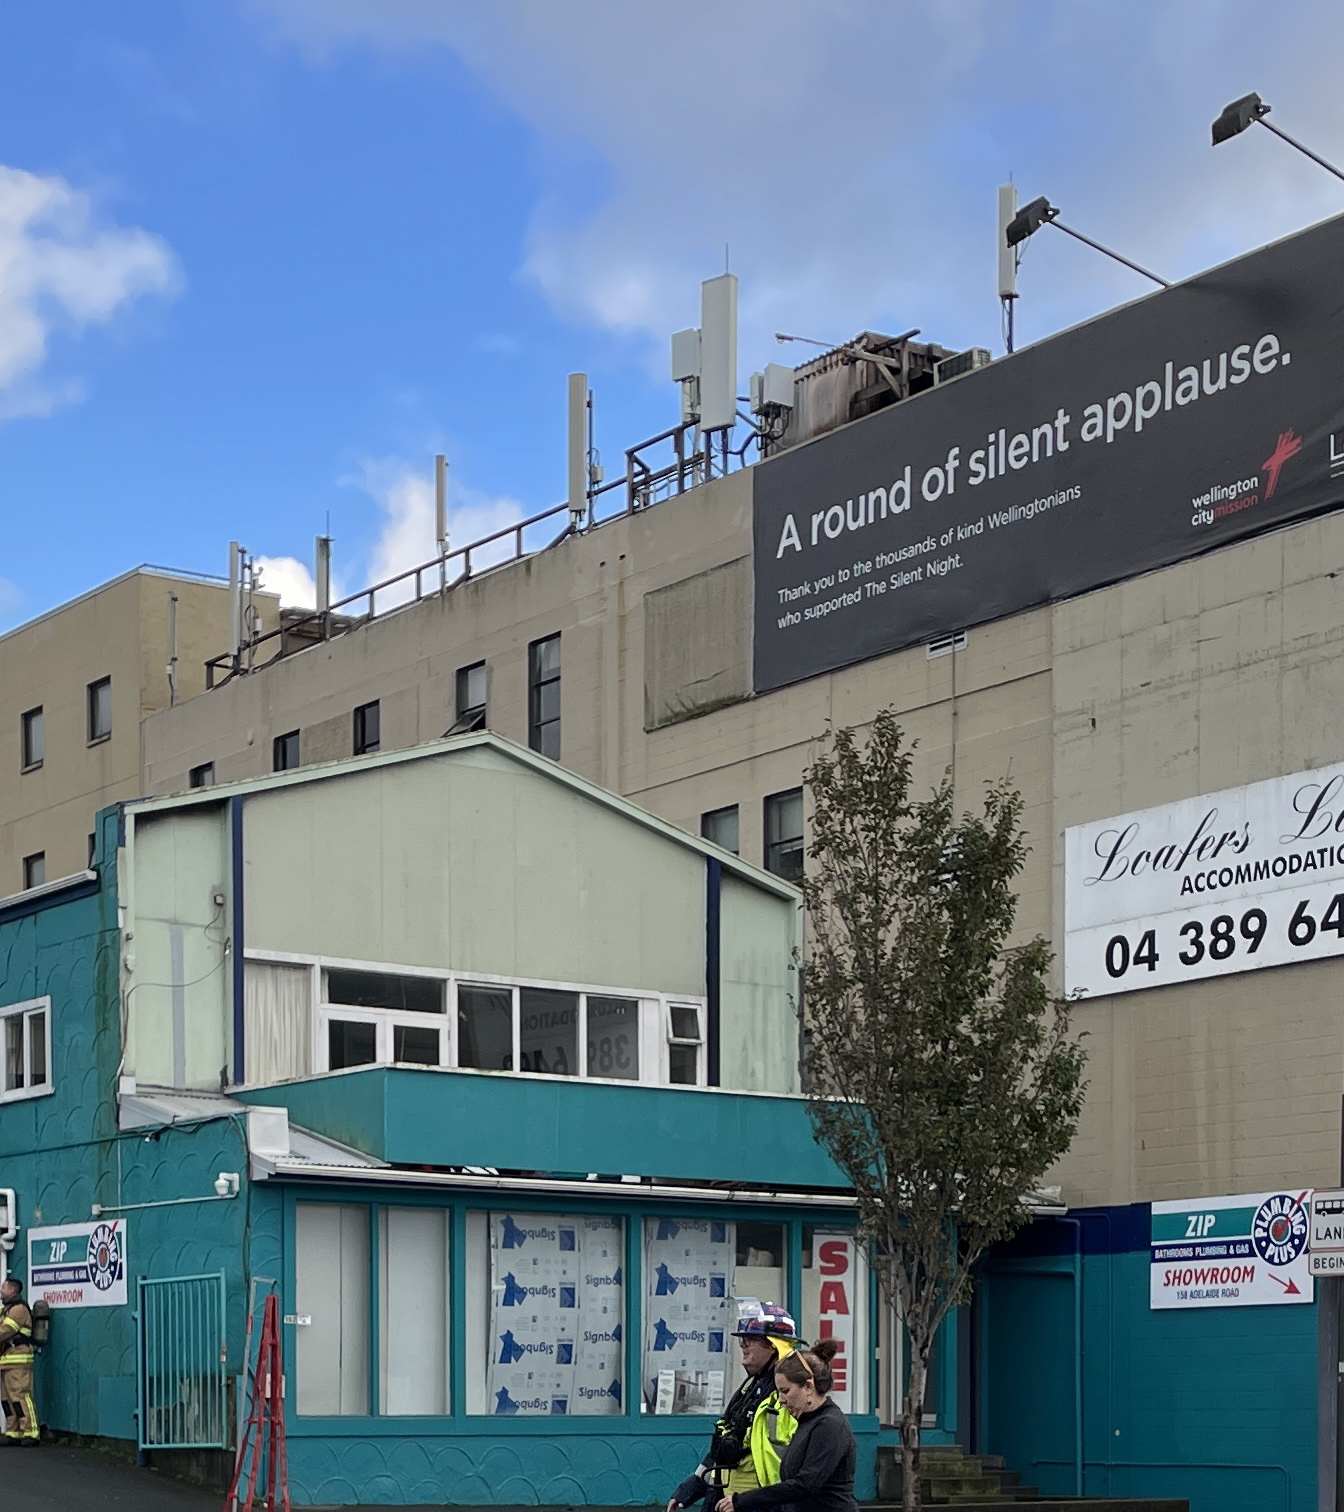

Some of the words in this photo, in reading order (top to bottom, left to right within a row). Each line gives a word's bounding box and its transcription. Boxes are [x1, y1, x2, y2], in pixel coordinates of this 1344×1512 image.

[776, 513, 803, 559] A
[810, 466, 912, 546] round
[921, 447, 962, 502] of
[968, 412, 1071, 486] silent
[1080, 332, 1292, 443] applause.
[1191, 476, 1259, 509] wellington
[777, 580, 811, 604] Thank
[813, 573, 834, 595] you
[838, 568, 850, 583] to
[853, 560, 872, 578] the
[875, 535, 936, 570] thousands
[940, 527, 954, 547] of
[957, 517, 984, 541] kind
[987, 485, 1081, 529] Wellingtonians
[777, 611, 801, 629] who
[803, 586, 861, 621] supported
[864, 581, 887, 598] The
[889, 566, 923, 590] Silent
[926, 553, 964, 578] Night.
[1083, 807, 1255, 887] Loafers
[1105, 927, 1160, 978] 04
[1179, 908, 1268, 966] 389
[1185, 1214, 1216, 1238] ZIP
[49, 1241, 67, 1262] ZIP
[1264, 1241, 1296, 1264] PLUS
[1163, 1265, 1256, 1287] SHOWROOM
[1189, 1288, 1220, 1299] ADELAIDE
[1221, 1287, 1240, 1298] ROAD
